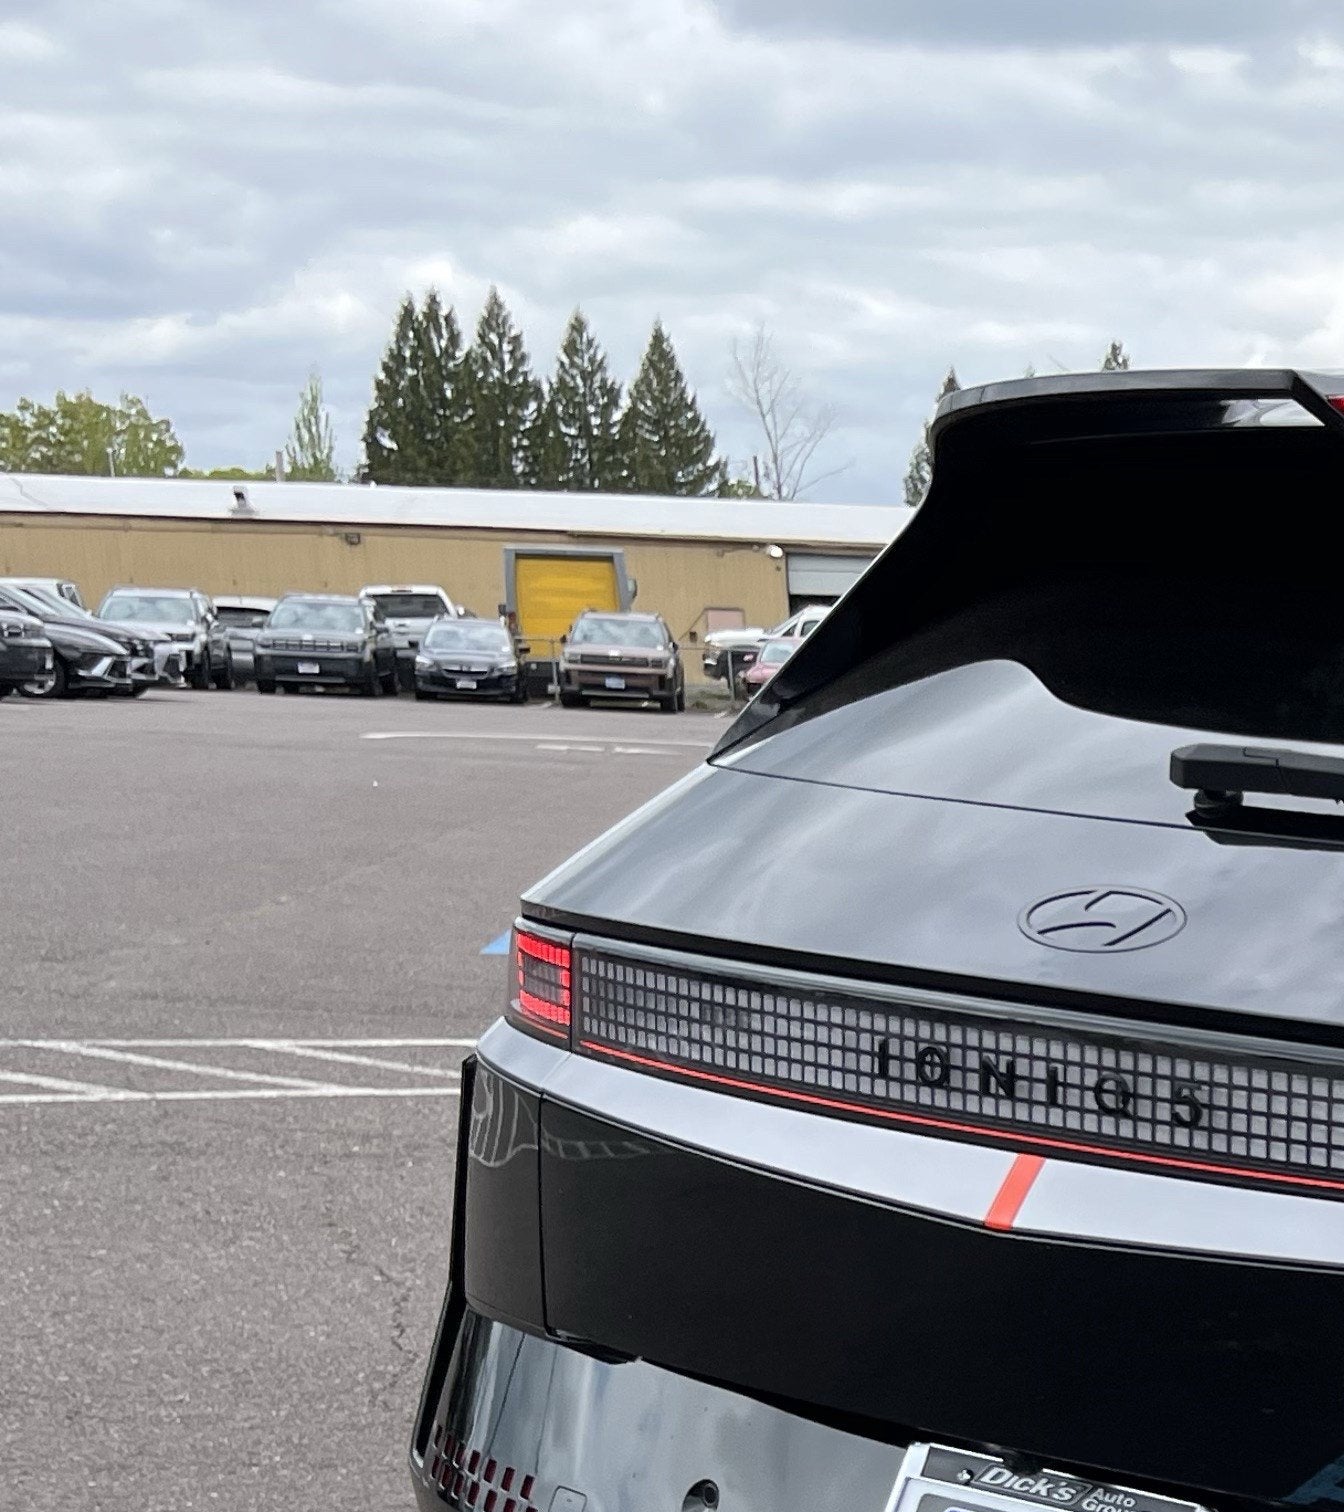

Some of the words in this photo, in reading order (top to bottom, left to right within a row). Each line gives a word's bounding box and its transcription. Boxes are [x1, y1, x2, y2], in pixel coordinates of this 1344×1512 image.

[878, 1036, 1133, 1120] IONIQ
[980, 1466, 1077, 1502] Dick's
[1089, 1487, 1136, 1508] Auto
